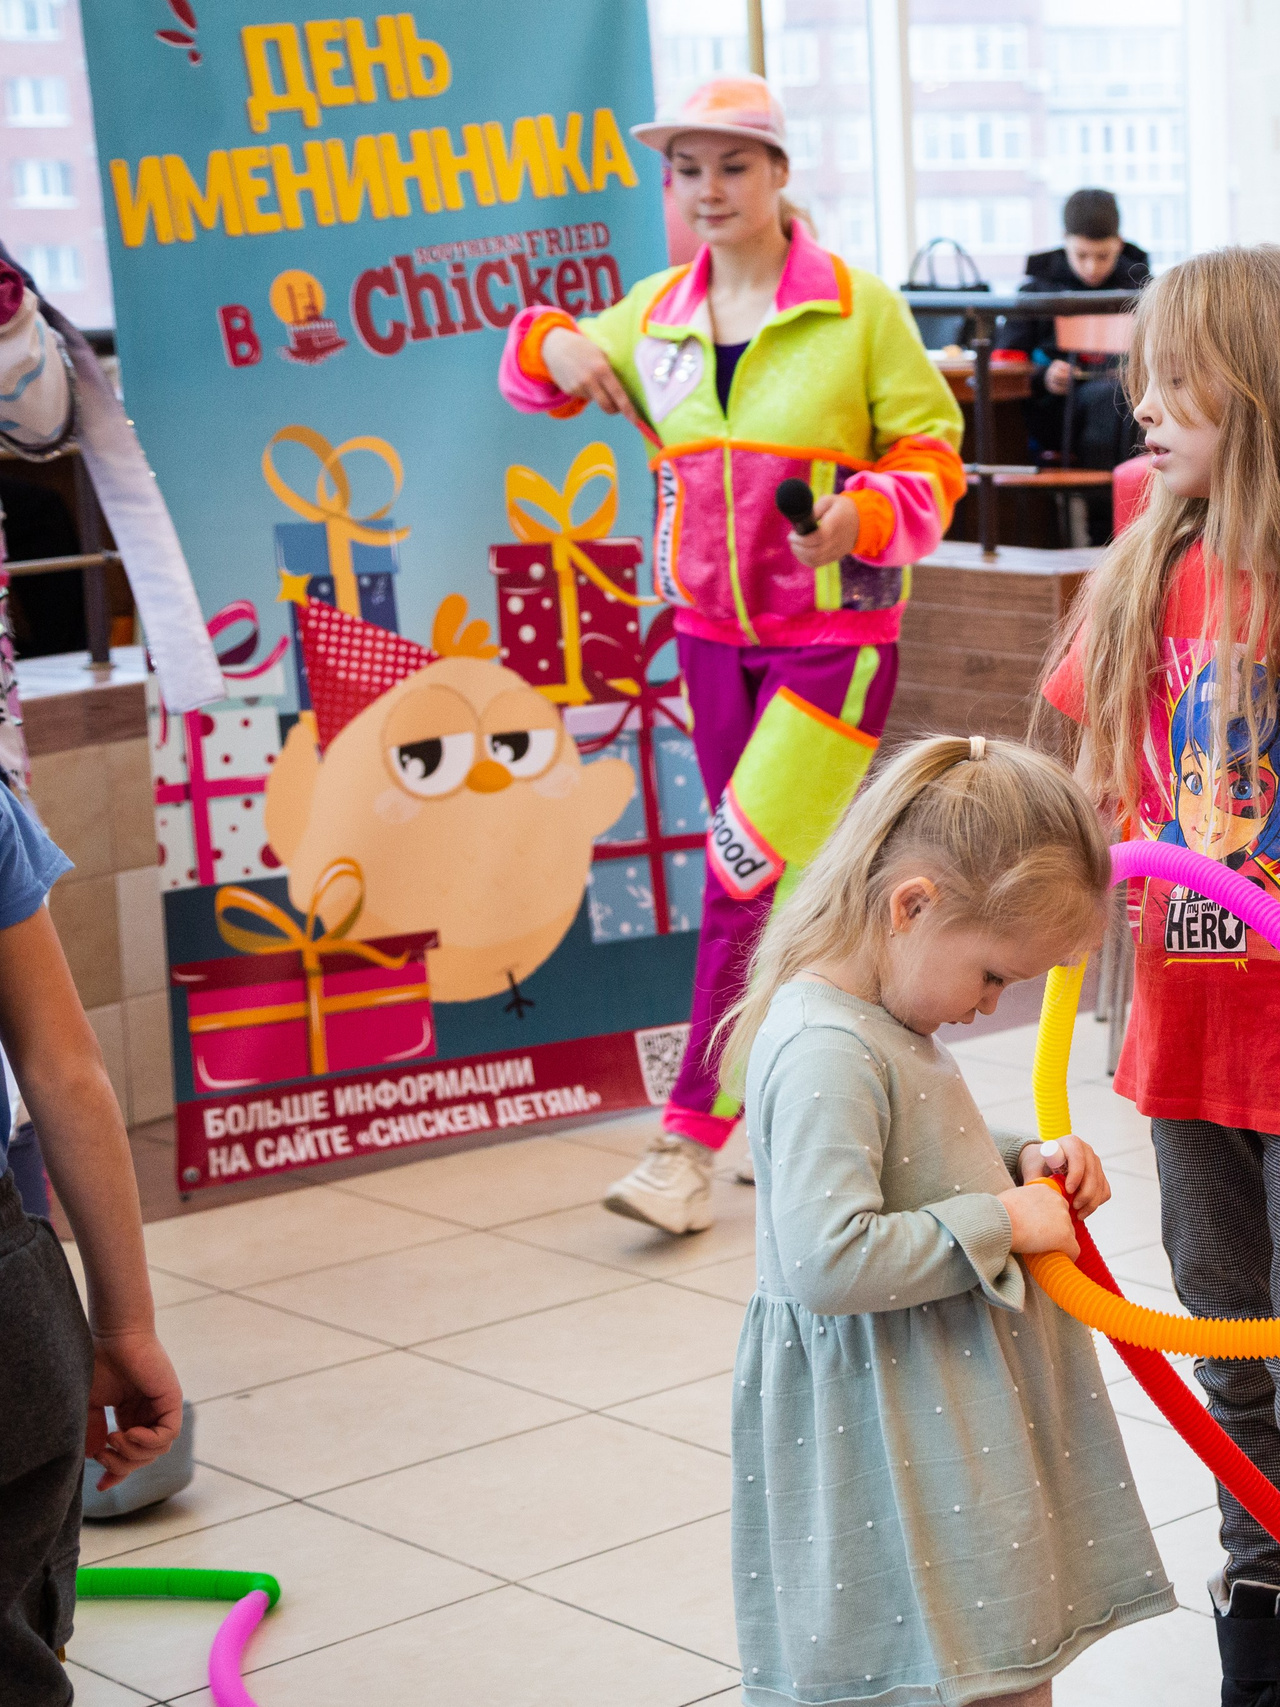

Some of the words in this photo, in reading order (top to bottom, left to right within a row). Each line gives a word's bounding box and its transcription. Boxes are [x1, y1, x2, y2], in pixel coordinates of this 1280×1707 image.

[240, 12, 452, 134] ДЕНЬ
[109, 107, 640, 248] ИМЕНИННИКА
[523, 221, 611, 259] FRIED
[350, 252, 626, 356] Chicken
[1167, 903, 1243, 950] HERO
[1187, 903, 1198, 915] my
[203, 1089, 331, 1140] БОЛЬШЕ
[332, 1056, 536, 1118] ИНФОРМАЦИИ
[208, 1142, 253, 1178] НА
[255, 1123, 354, 1169] САЙТЕ
